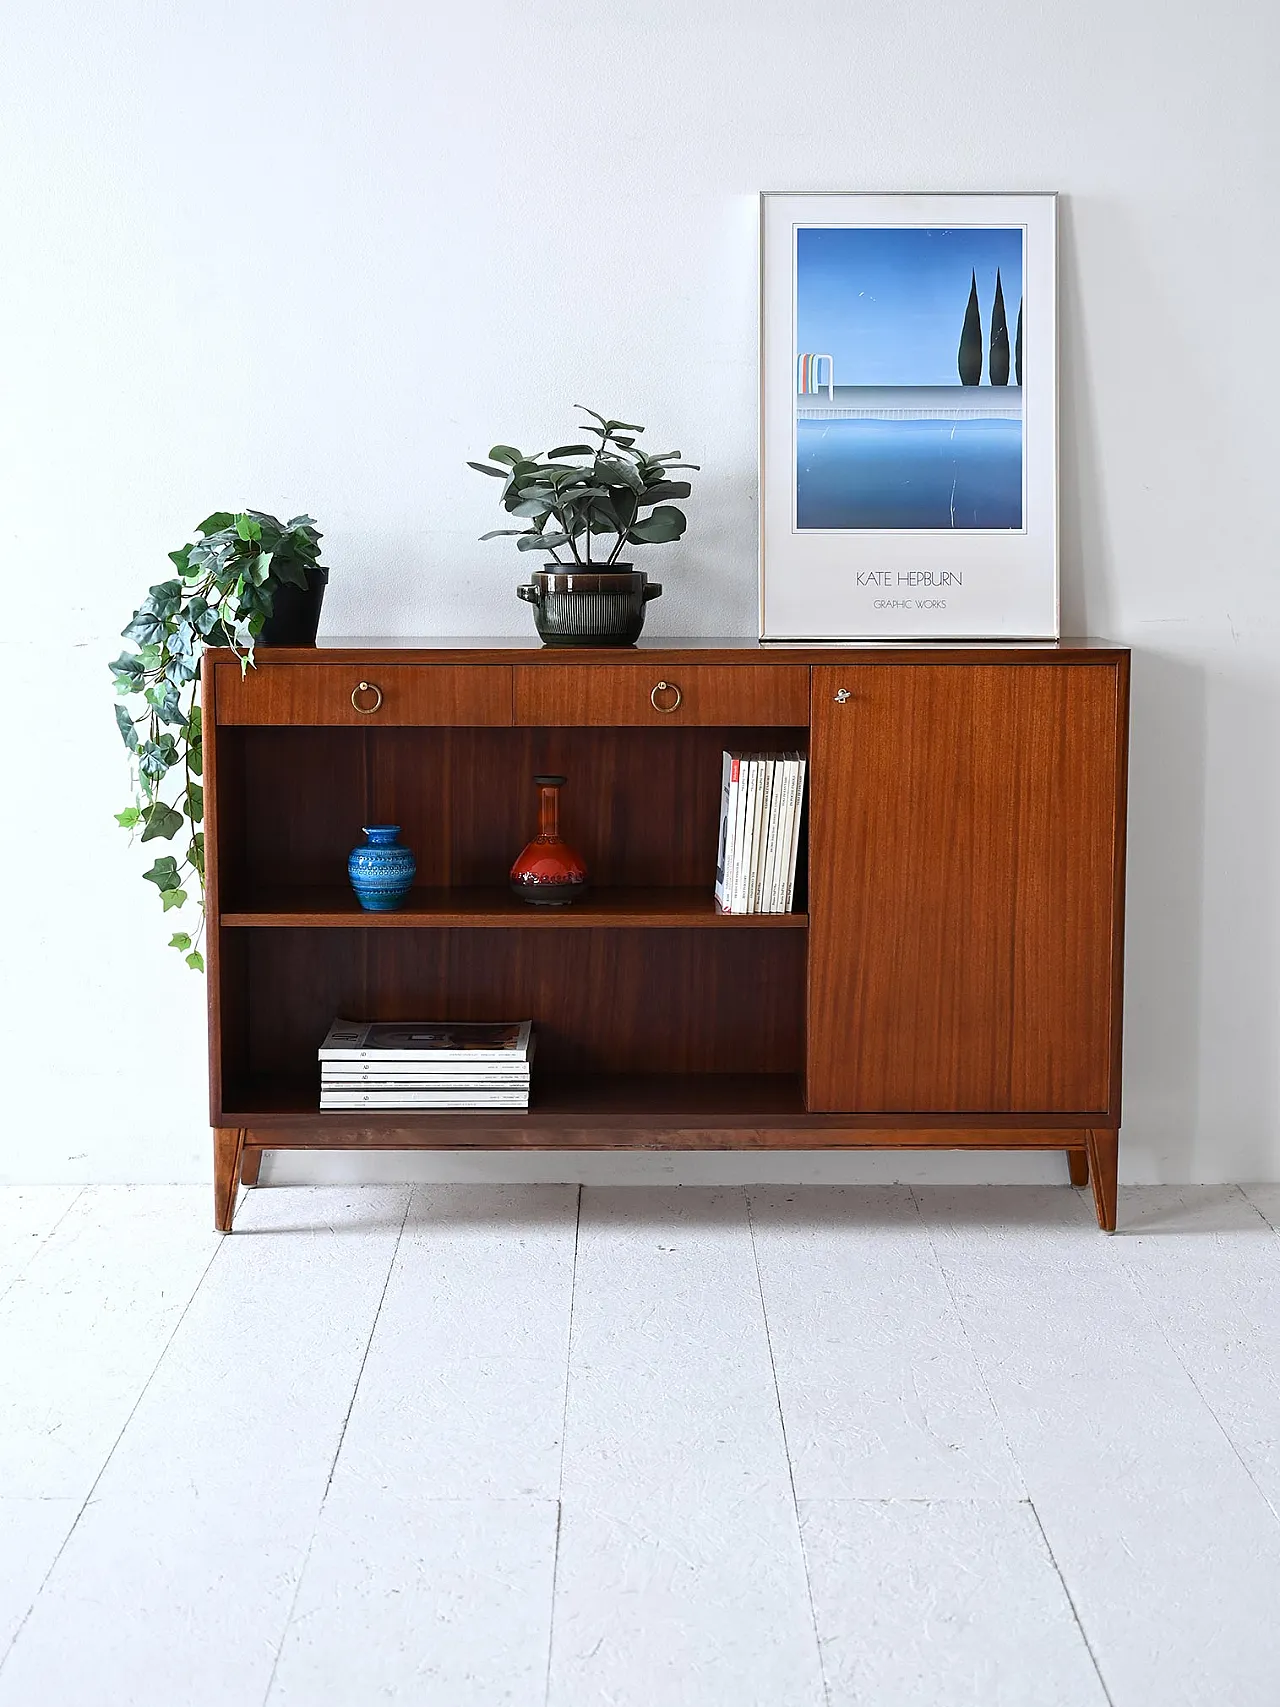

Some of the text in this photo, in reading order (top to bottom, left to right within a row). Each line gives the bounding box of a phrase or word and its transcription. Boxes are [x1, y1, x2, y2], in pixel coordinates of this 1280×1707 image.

[856, 571, 963, 586] KATE HEPBURN
[873, 599, 947, 609] GRAPHIC WORKS
